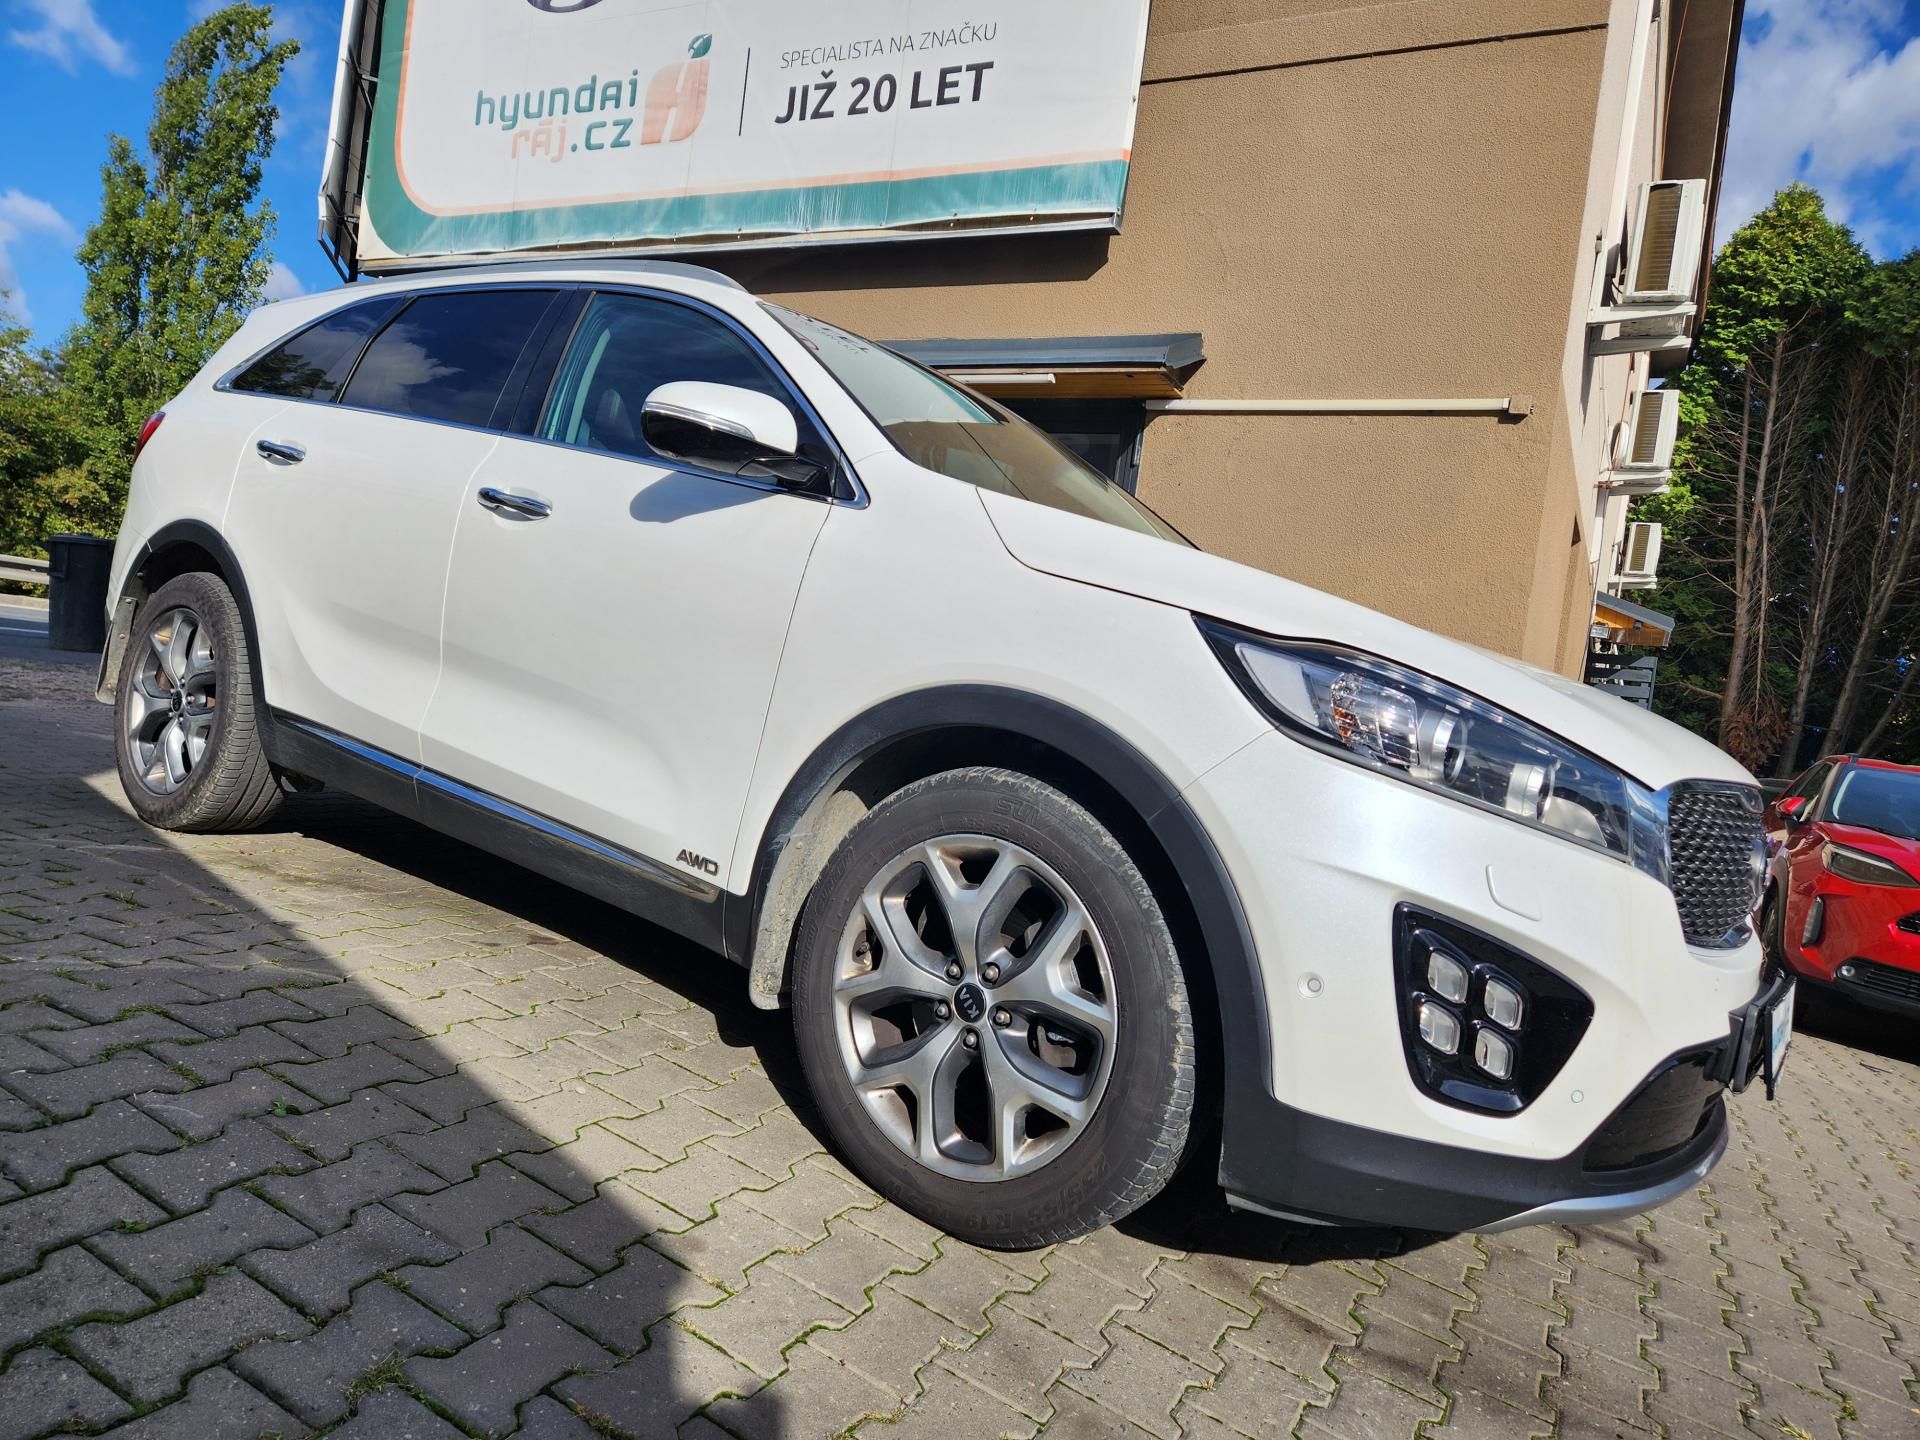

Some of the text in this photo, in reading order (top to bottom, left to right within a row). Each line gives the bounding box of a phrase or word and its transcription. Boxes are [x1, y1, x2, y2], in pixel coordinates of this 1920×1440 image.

[780, 20, 997, 69] SPECIALISTA NA ZNAČKU
[774, 60, 995, 124] JIŽ 20 LET
[676, 848, 720, 876] AWD
[959, 986, 981, 1019] KIA
